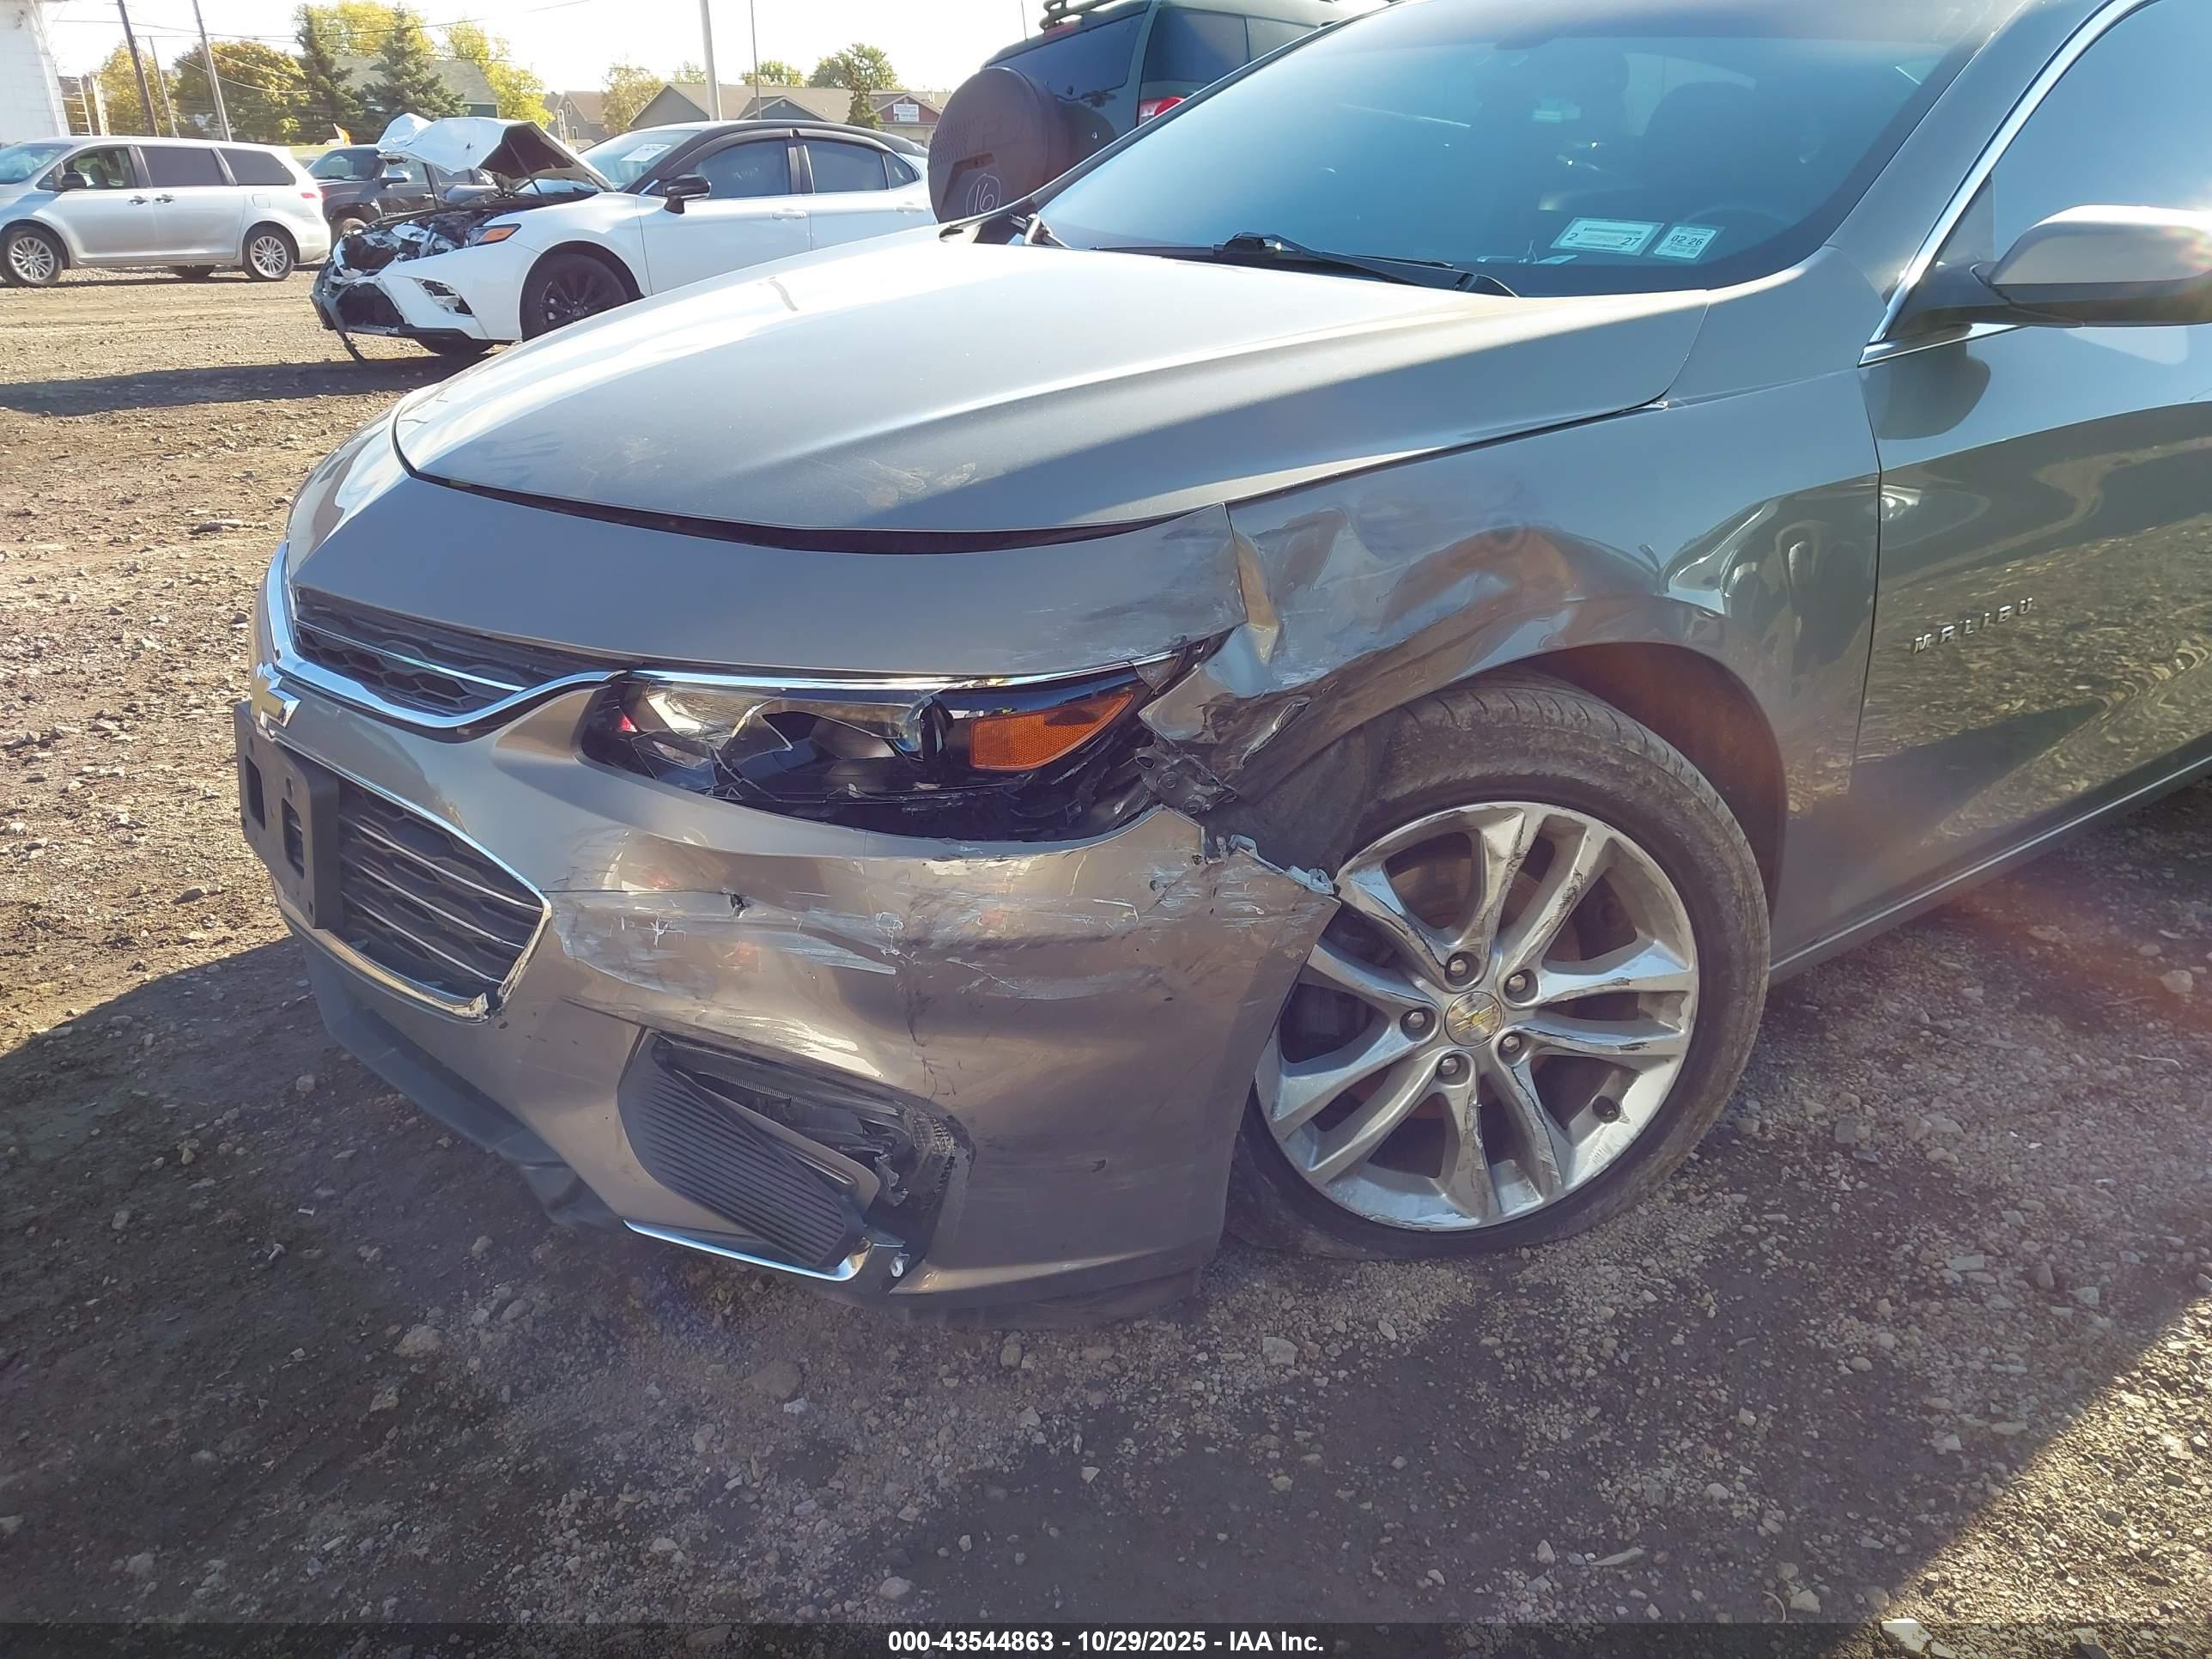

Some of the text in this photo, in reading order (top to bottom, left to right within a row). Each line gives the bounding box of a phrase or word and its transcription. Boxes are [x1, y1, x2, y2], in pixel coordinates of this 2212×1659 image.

[975, 182, 994, 214] 16
[1567, 233, 1577, 241] 2
[1621, 237, 1640, 246] 27
[1911, 597, 2033, 654] MALIBU
